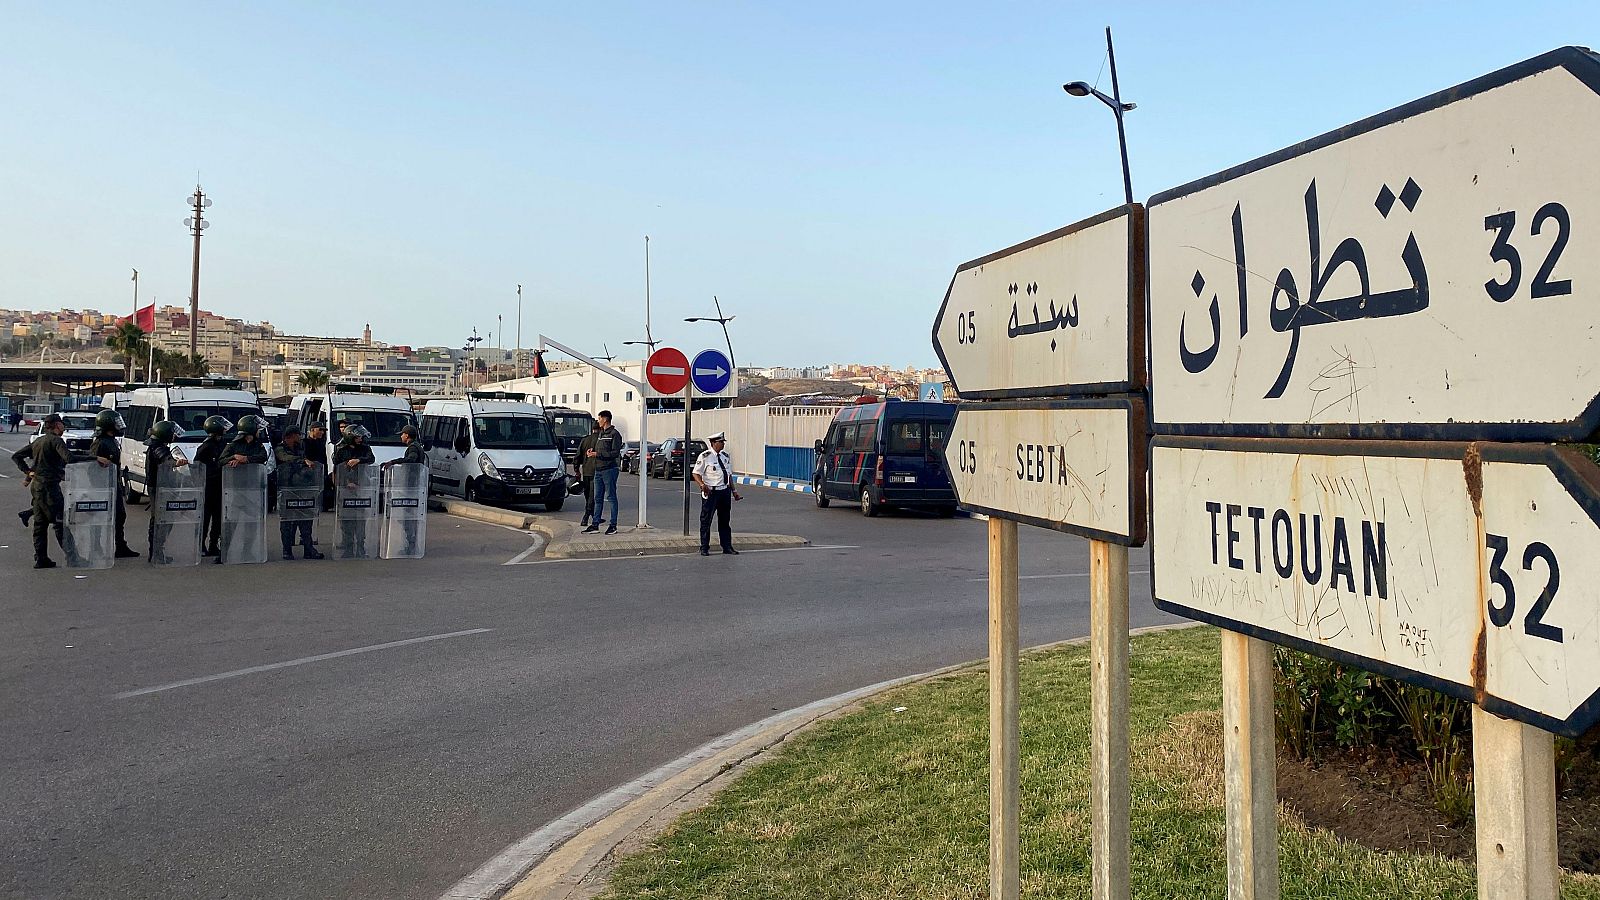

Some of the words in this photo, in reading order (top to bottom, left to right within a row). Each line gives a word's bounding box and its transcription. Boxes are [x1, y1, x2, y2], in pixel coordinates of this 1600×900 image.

[1179, 176, 1430, 399] تطوان
[1484, 202, 1572, 303] 32
[958, 310, 976, 345] 0.5
[1007, 281, 1079, 353] سبتة
[959, 439, 977, 475] 0.5
[1016, 443, 1068, 486] SEBTA
[1205, 501, 1389, 600] TETOUAN
[1485, 533, 1564, 644] 32
